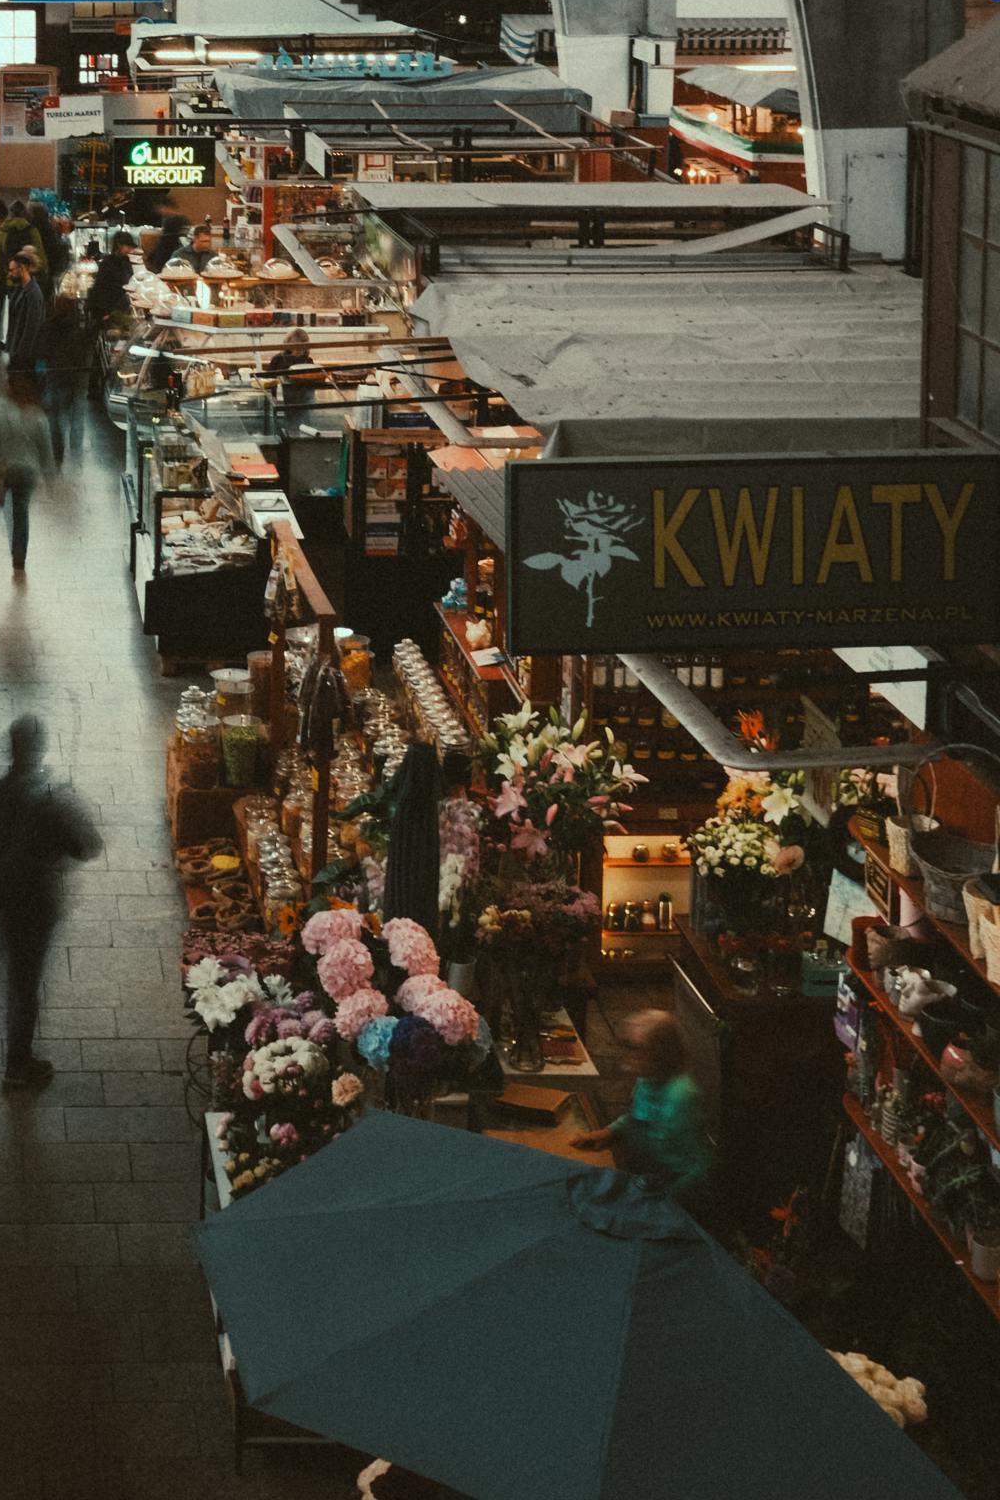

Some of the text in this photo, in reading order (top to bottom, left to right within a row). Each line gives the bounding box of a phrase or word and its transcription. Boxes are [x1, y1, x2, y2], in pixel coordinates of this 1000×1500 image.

[75, 109, 102, 117] MARKET
[123, 165, 206, 184] TARGOWA
[653, 483, 976, 588] KWIATY
[647, 605, 973, 628] WWW.KWIATY-MARZENA.PL
